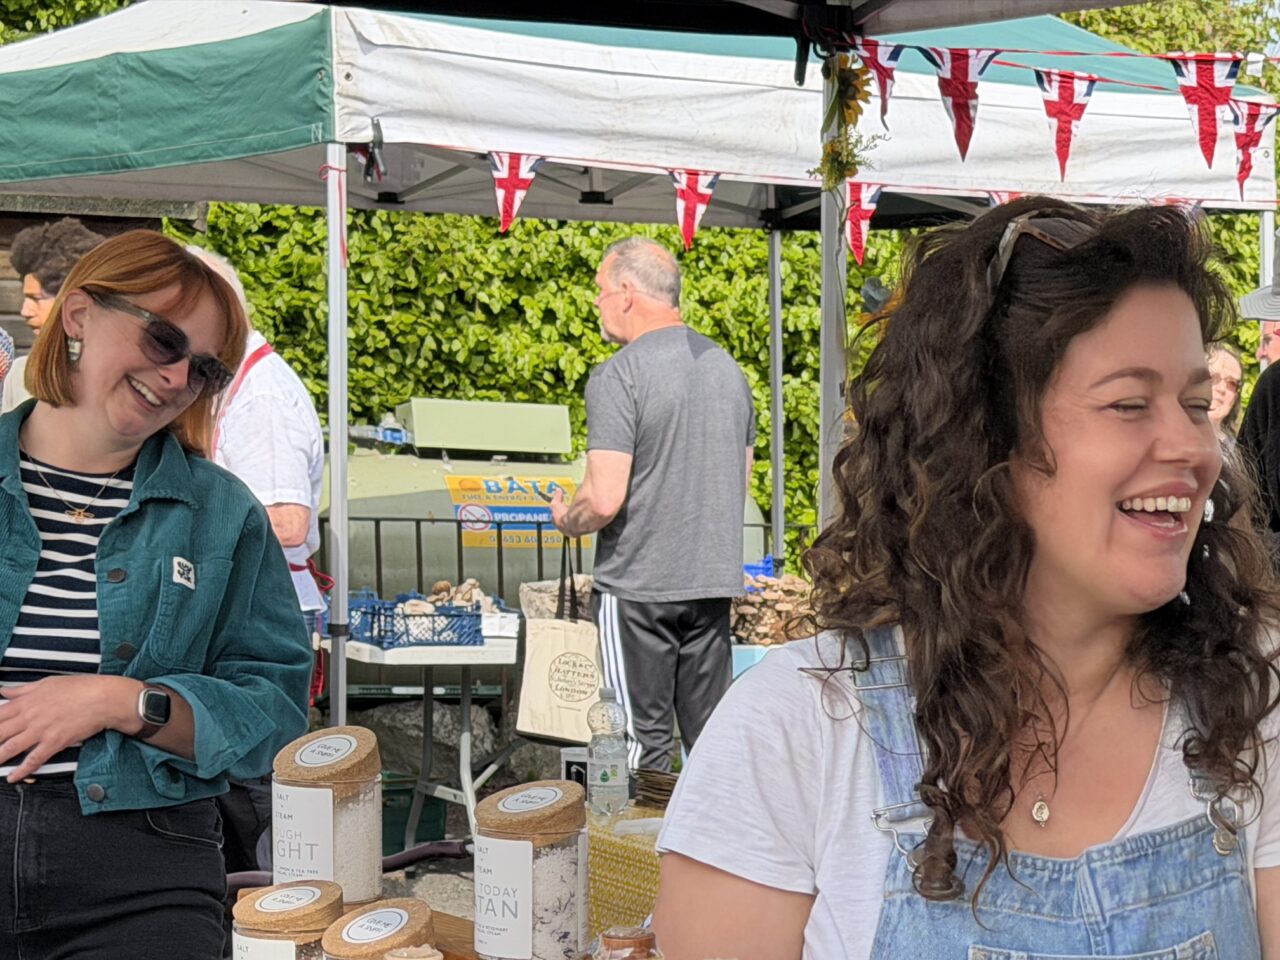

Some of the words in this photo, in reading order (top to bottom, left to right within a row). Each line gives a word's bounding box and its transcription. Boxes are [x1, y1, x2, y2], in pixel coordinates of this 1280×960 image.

[483, 480, 567, 494] BATA
[493, 512, 548, 522] PROPANE
[479, 883, 518, 898] TODAY
